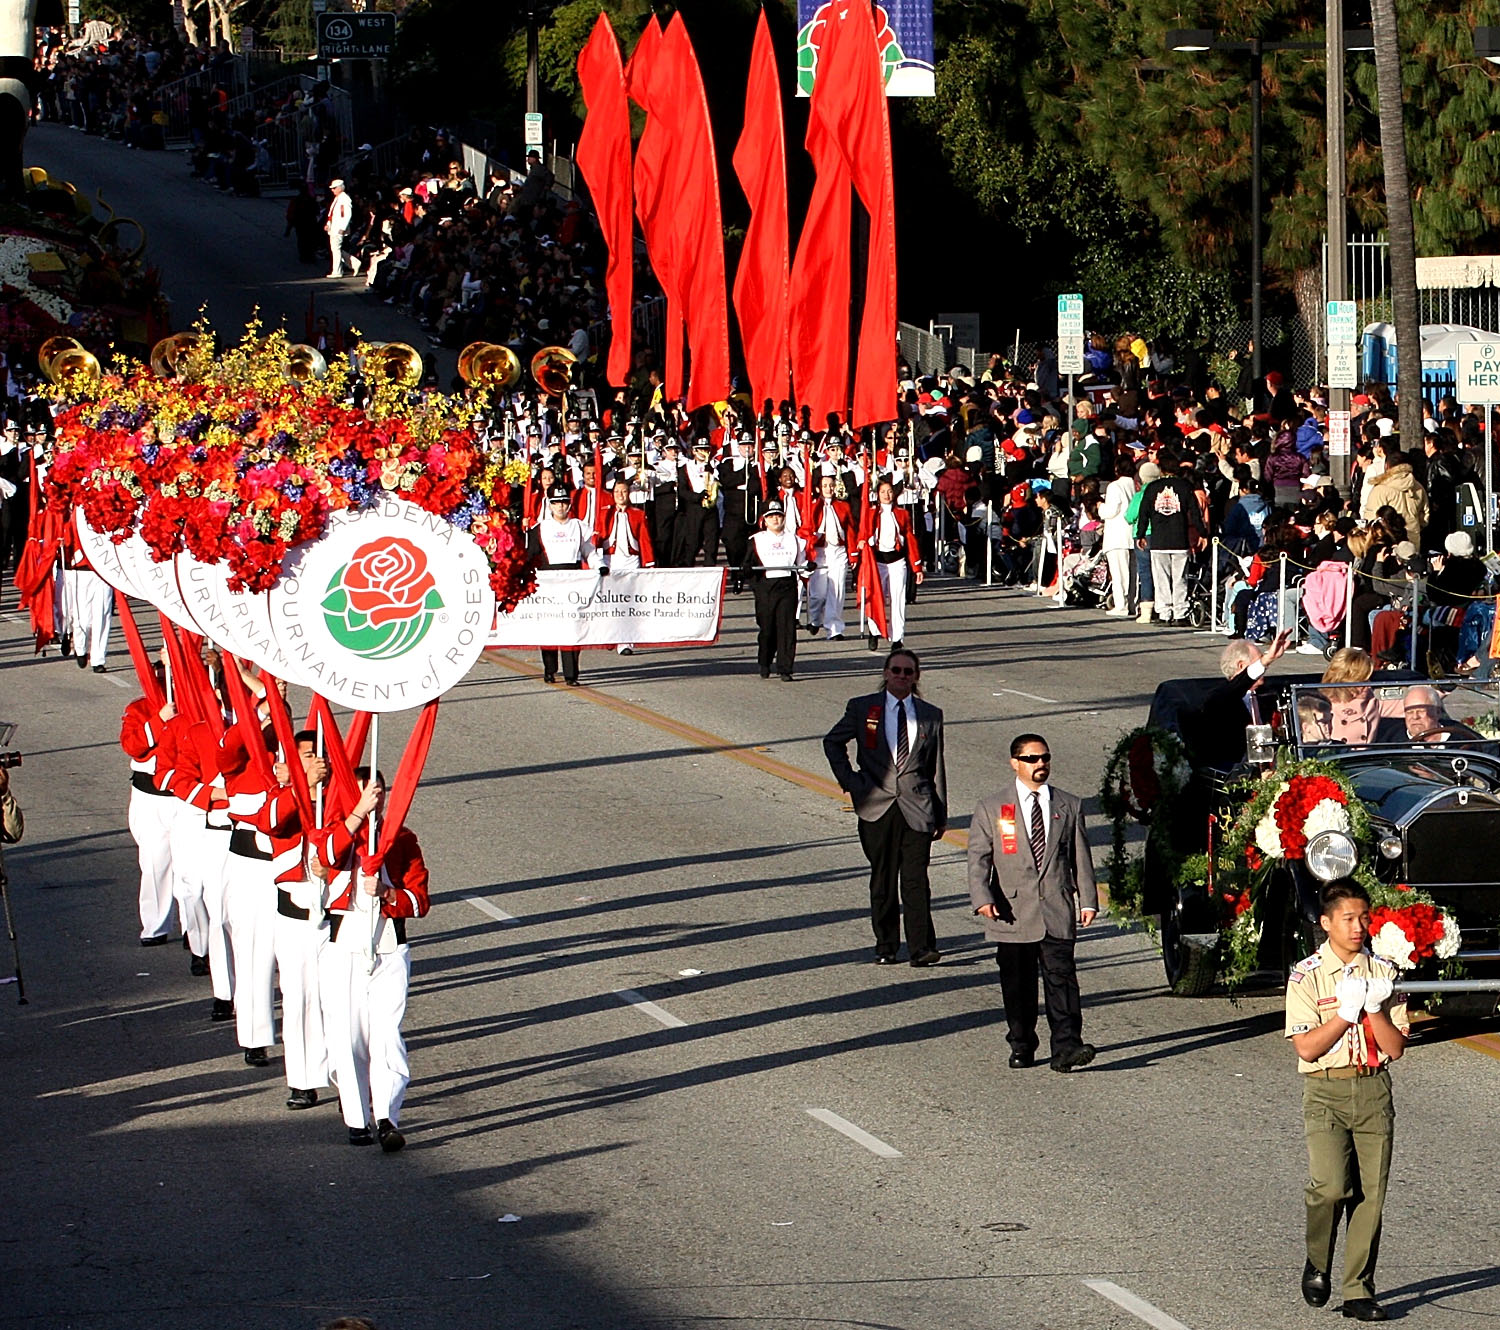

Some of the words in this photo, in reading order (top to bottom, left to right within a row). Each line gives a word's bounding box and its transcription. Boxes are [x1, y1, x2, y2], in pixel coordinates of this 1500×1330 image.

[358, 18, 387, 27] WEST
[330, 26, 349, 36] 134
[322, 45, 356, 53] RIGHT
[362, 45, 391, 53] LANE
[331, 502, 455, 546] ASADENA
[594, 589, 631, 604] Salute
[635, 594, 648, 604] to
[652, 591, 673, 604] the
[677, 591, 716, 605] Bands
[537, 609, 564, 622] proud
[612, 607, 626, 617] the
[629, 607, 651, 618] Rose
[654, 608, 685, 619] Parade
[688, 609, 716, 619] bands
[282, 562, 409, 700] TOURNAMENT
[421, 654, 441, 690] of
[444, 567, 482, 666] ROSES
